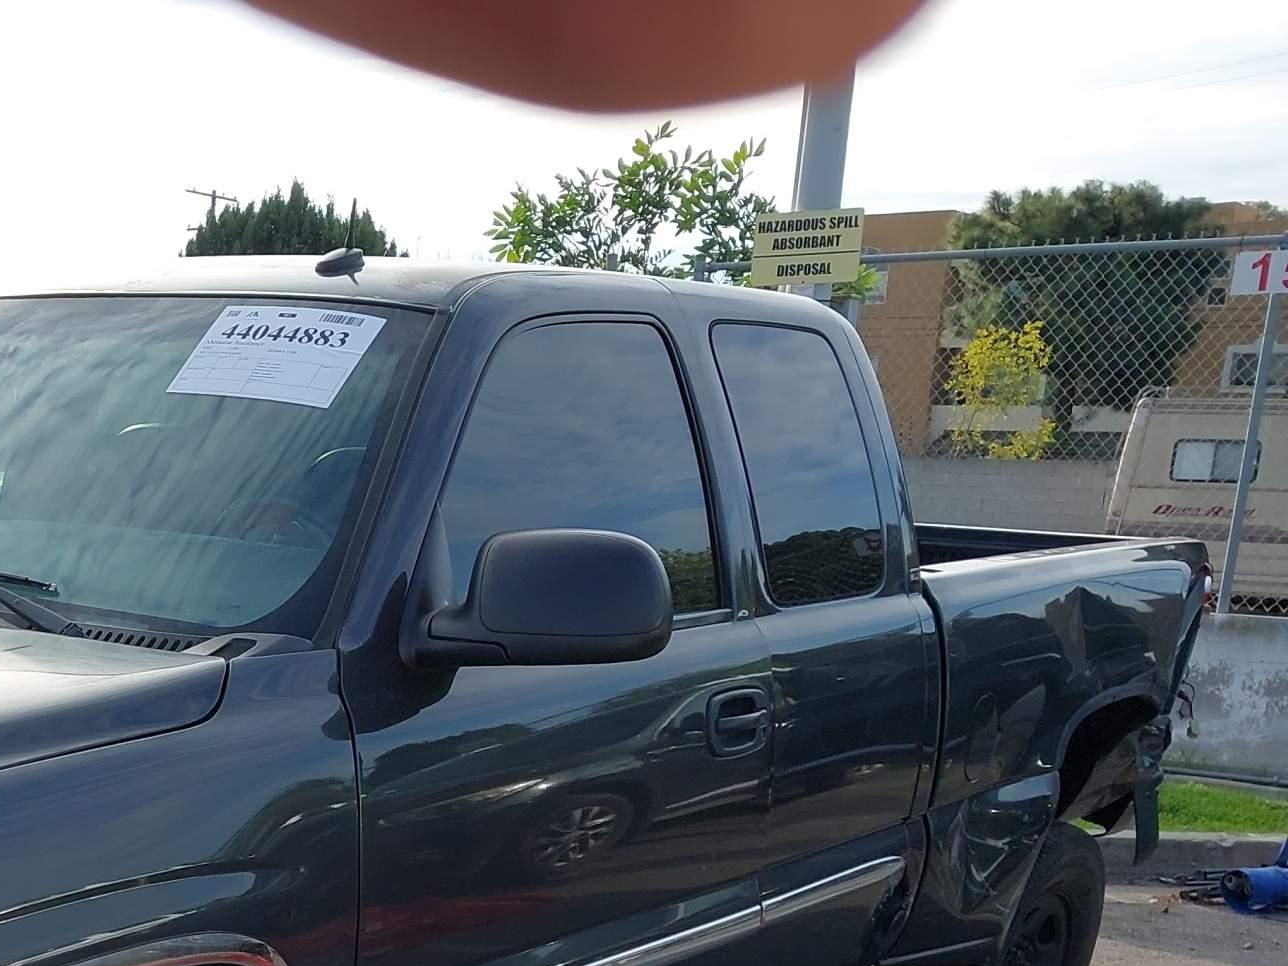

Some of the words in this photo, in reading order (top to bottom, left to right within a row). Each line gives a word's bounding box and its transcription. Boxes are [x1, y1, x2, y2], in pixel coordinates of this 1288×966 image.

[758, 217, 827, 234] HAZARDOUS
[829, 215, 860, 229] SPILL
[772, 234, 842, 251] ABSORBANT
[776, 262, 832, 277] DISPOSAL
[220, 323, 350, 348] 44044883
